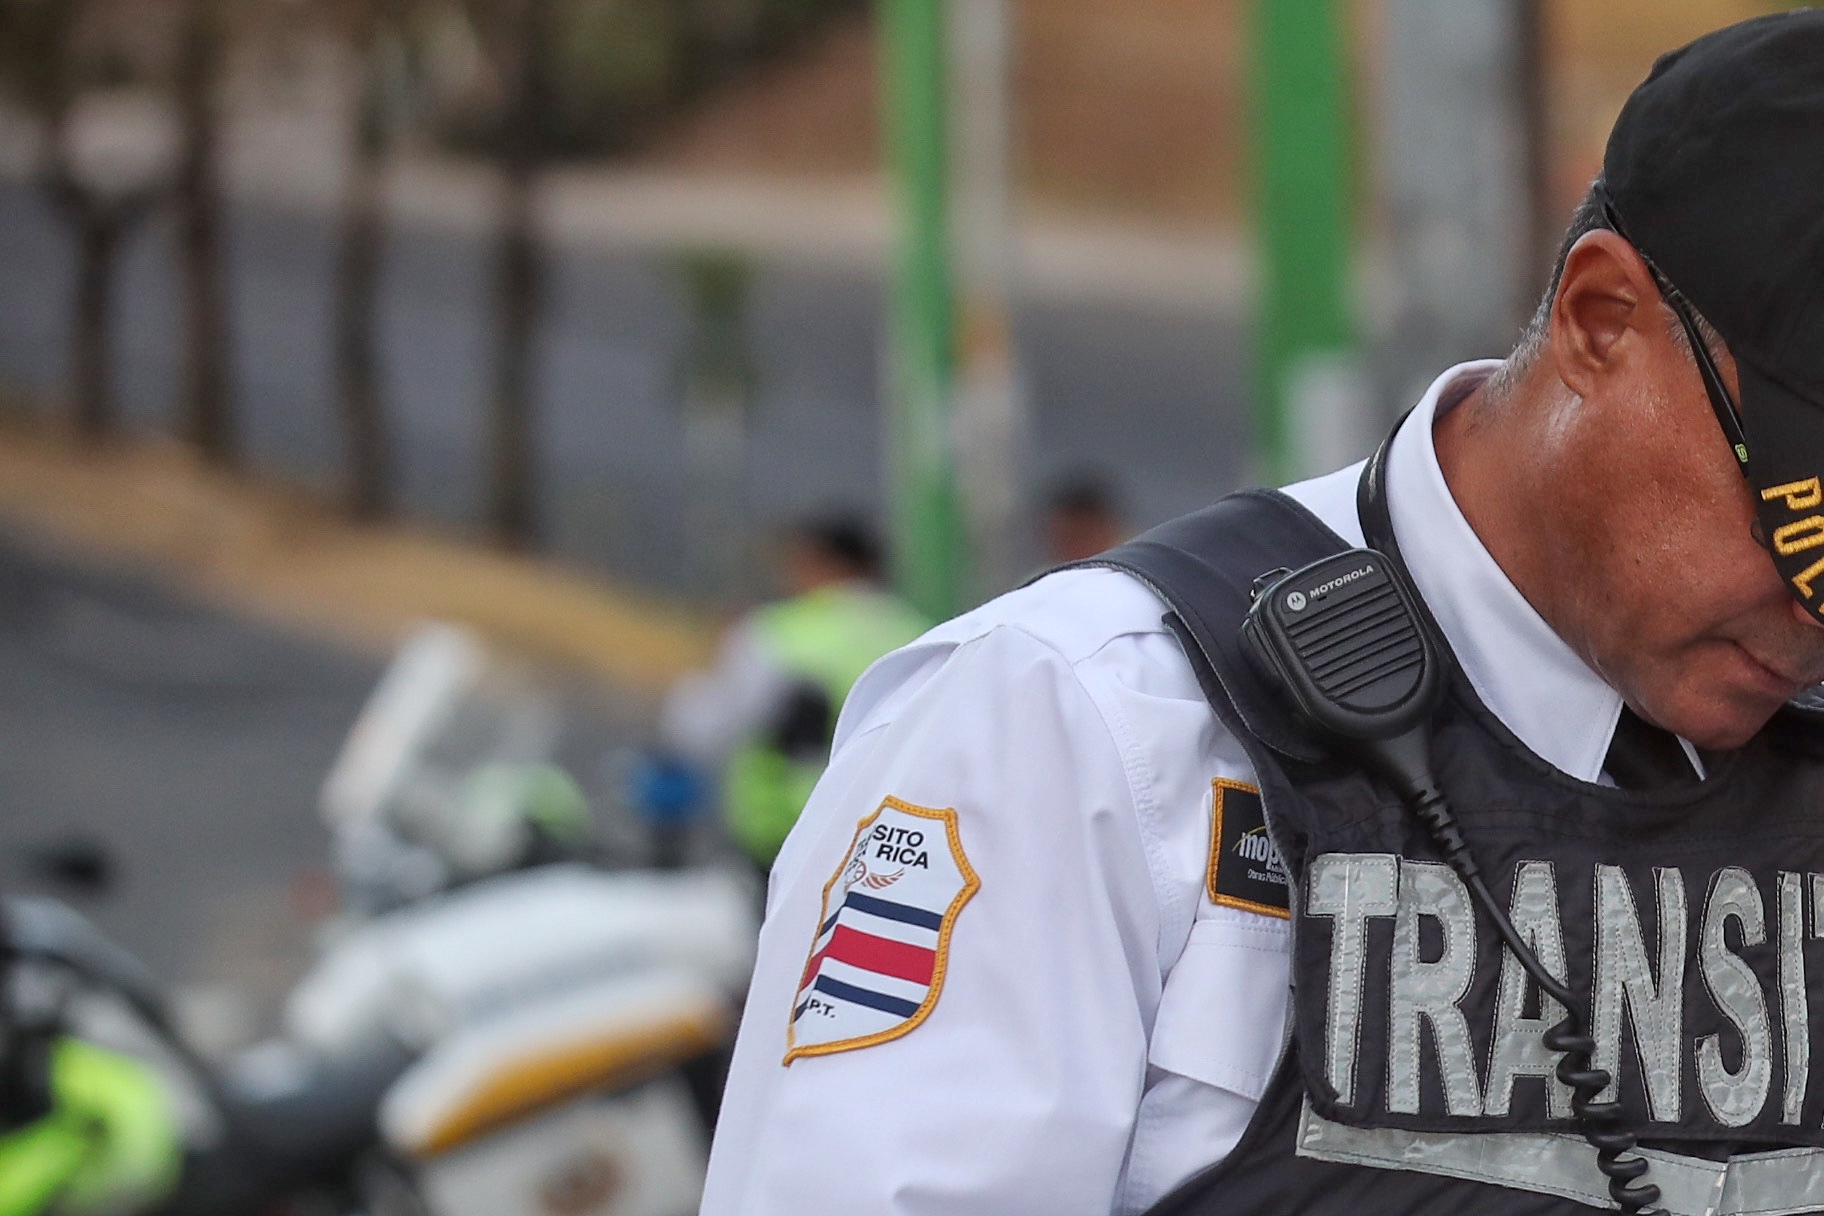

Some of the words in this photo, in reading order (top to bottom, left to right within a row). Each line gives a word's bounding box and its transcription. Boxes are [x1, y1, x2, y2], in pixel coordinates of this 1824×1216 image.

[1309, 565, 1373, 598] MOTOROLA
[873, 824, 924, 847] SITO
[876, 843, 928, 869] RICA
[1239, 832, 1281, 870] mop
[809, 999, 836, 1018] P.T.
